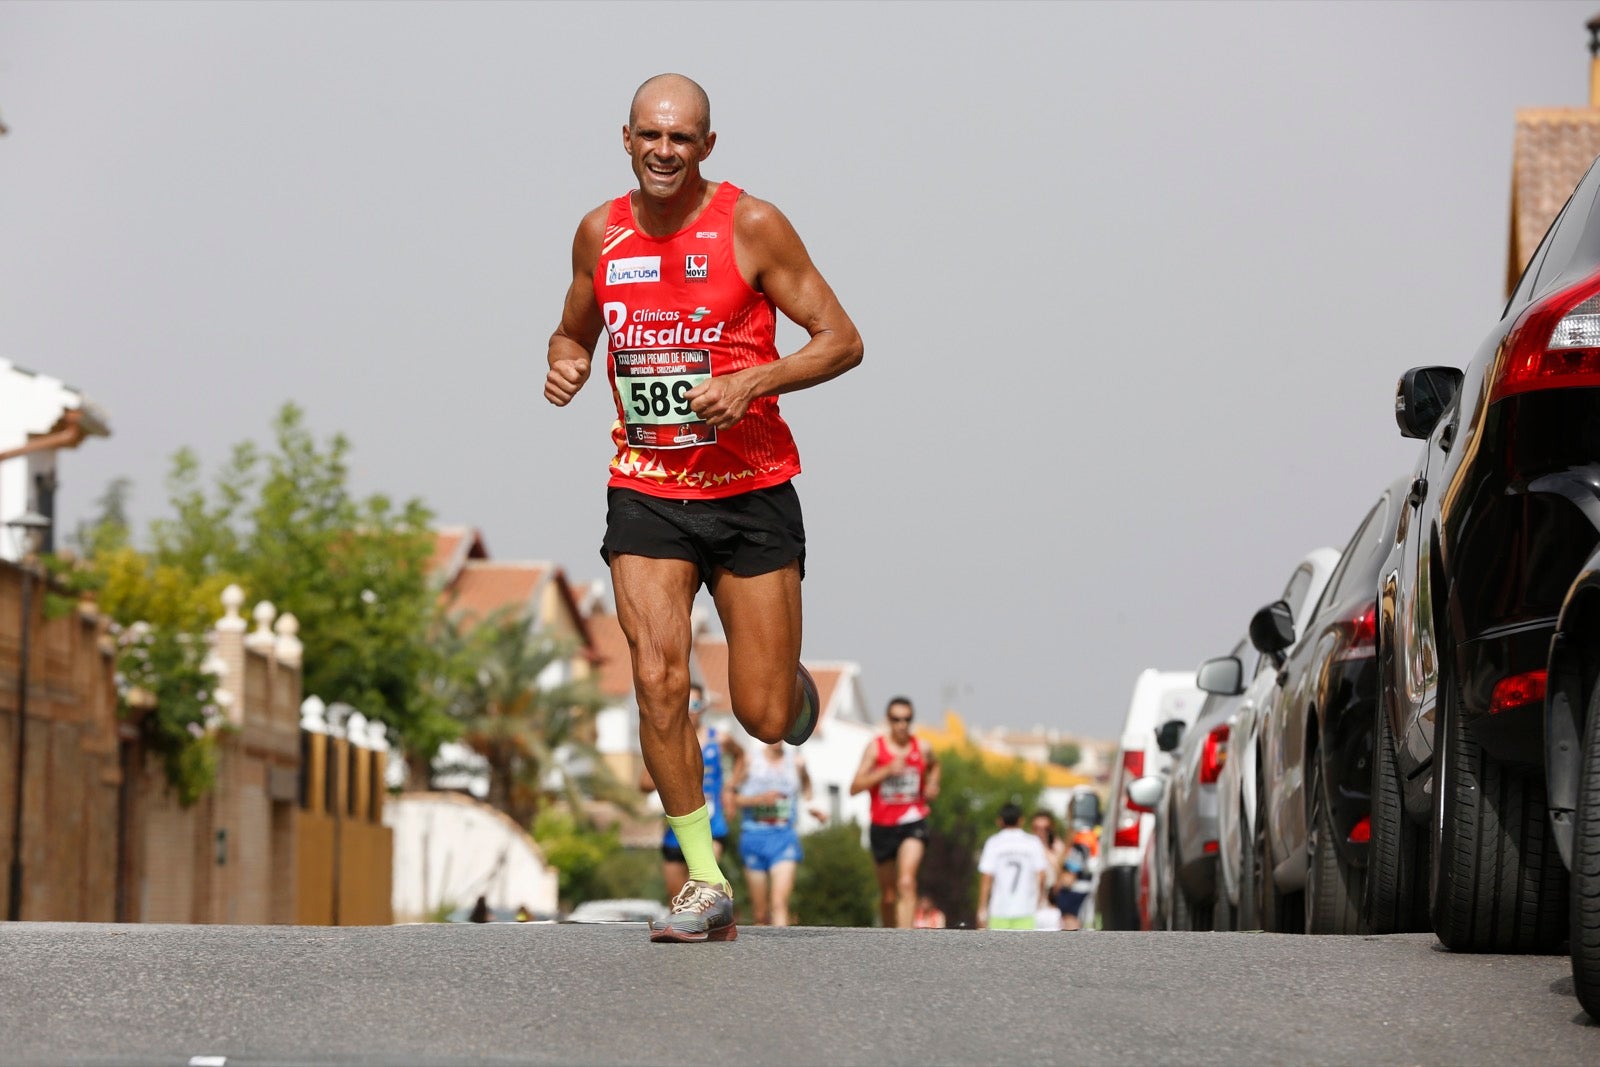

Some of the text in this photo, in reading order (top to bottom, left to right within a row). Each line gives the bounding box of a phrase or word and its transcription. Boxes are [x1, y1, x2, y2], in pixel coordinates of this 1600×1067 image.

[687, 257, 692, 269] I
[686, 269, 707, 277] MOVE
[632, 309, 680, 322] Clínicas
[603, 301, 725, 348] Polisalud
[630, 353, 646, 365] GRAN
[647, 352, 670, 364] PREMIO
[671, 351, 680, 363] DE
[682, 351, 704, 362] FONDO
[631, 380, 695, 417] 589
[1007, 861, 1022, 894] 7
